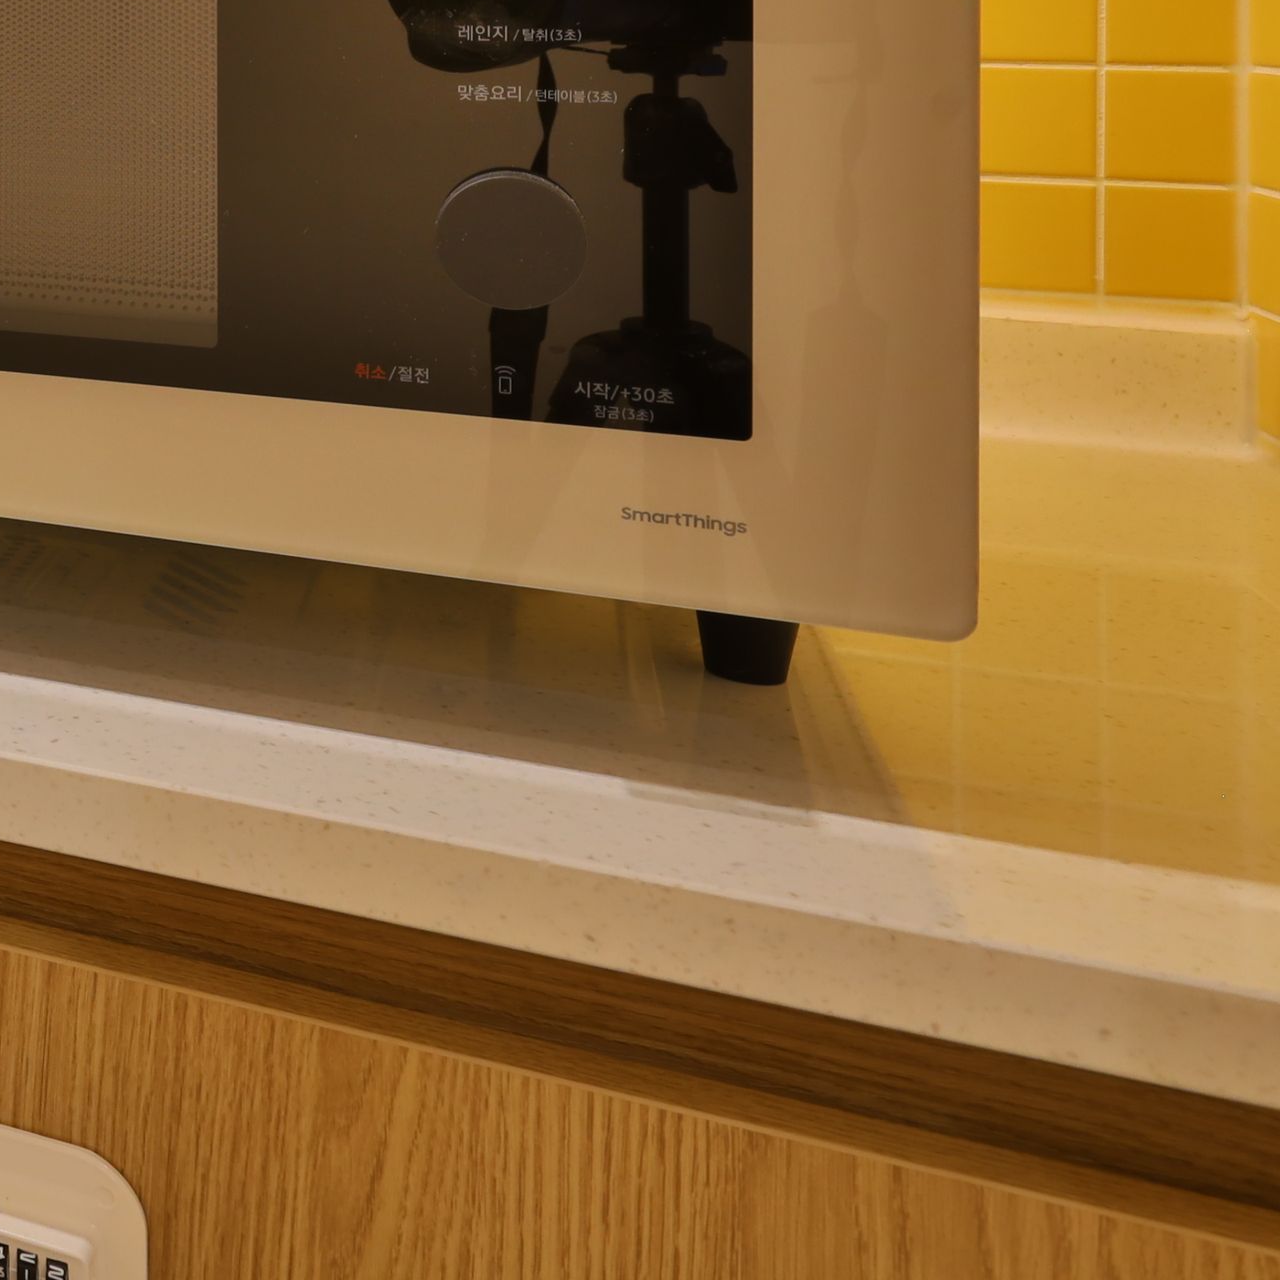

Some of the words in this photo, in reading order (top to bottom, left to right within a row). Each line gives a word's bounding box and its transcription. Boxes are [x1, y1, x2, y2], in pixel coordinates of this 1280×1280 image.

[457, 24, 509, 43] 레인지
[457, 84, 522, 103] 맞춤요리
[593, 405, 655, 423] 잠금(3초)
[620, 505, 747, 537] SmartThings
